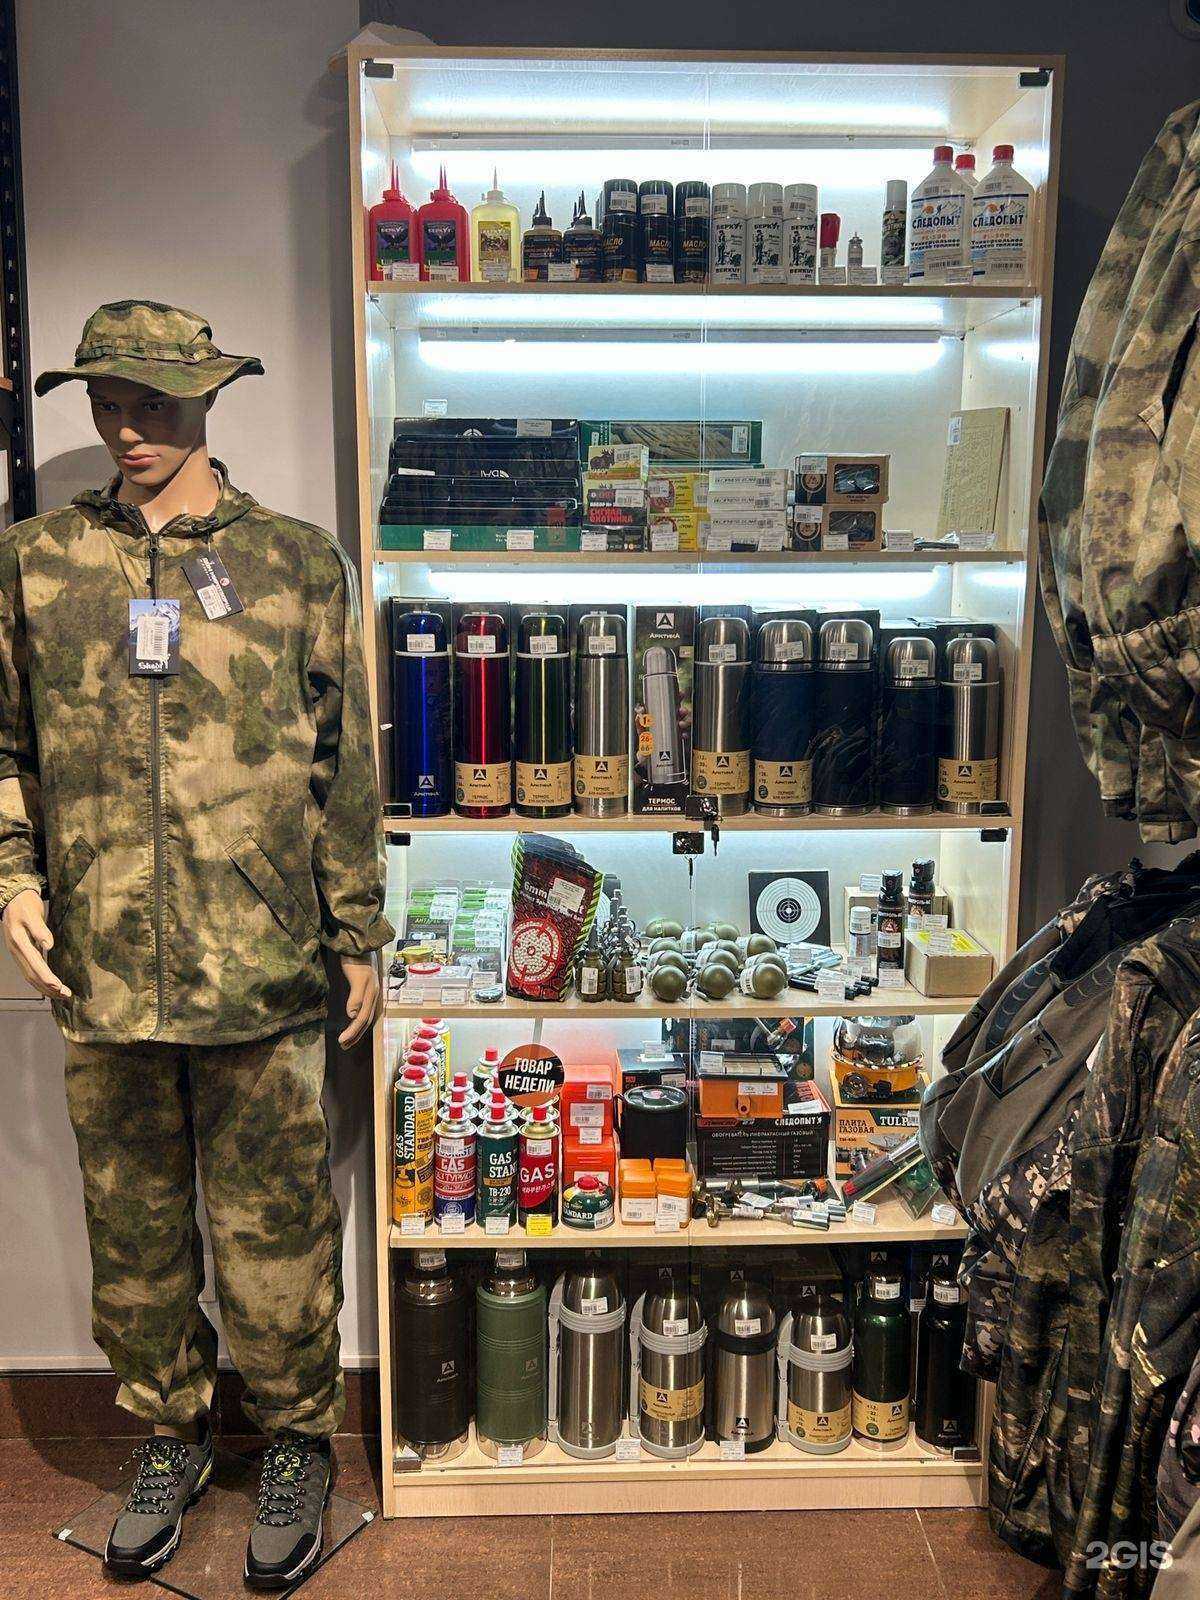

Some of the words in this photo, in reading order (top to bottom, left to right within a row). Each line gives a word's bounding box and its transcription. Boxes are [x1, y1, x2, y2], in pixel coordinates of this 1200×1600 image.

[912, 214, 961, 230] СЛЕДОПЫТ
[972, 214, 1025, 229] СЛЕДОПЫТ
[524, 881, 548, 899] 6mm
[514, 1057, 553, 1076] ТОВАР
[504, 1074, 556, 1093] НЕДЕЛИ
[404, 1096, 415, 1160] STANDARD
[839, 1119, 867, 1127] ПЛИТА
[839, 1126, 875, 1134] ГАЗОВАЯ
[396, 1134, 404, 1158] GAS
[441, 1157, 465, 1173] GAS
[489, 1152, 512, 1166] GAS
[520, 1162, 555, 1184] GAS
